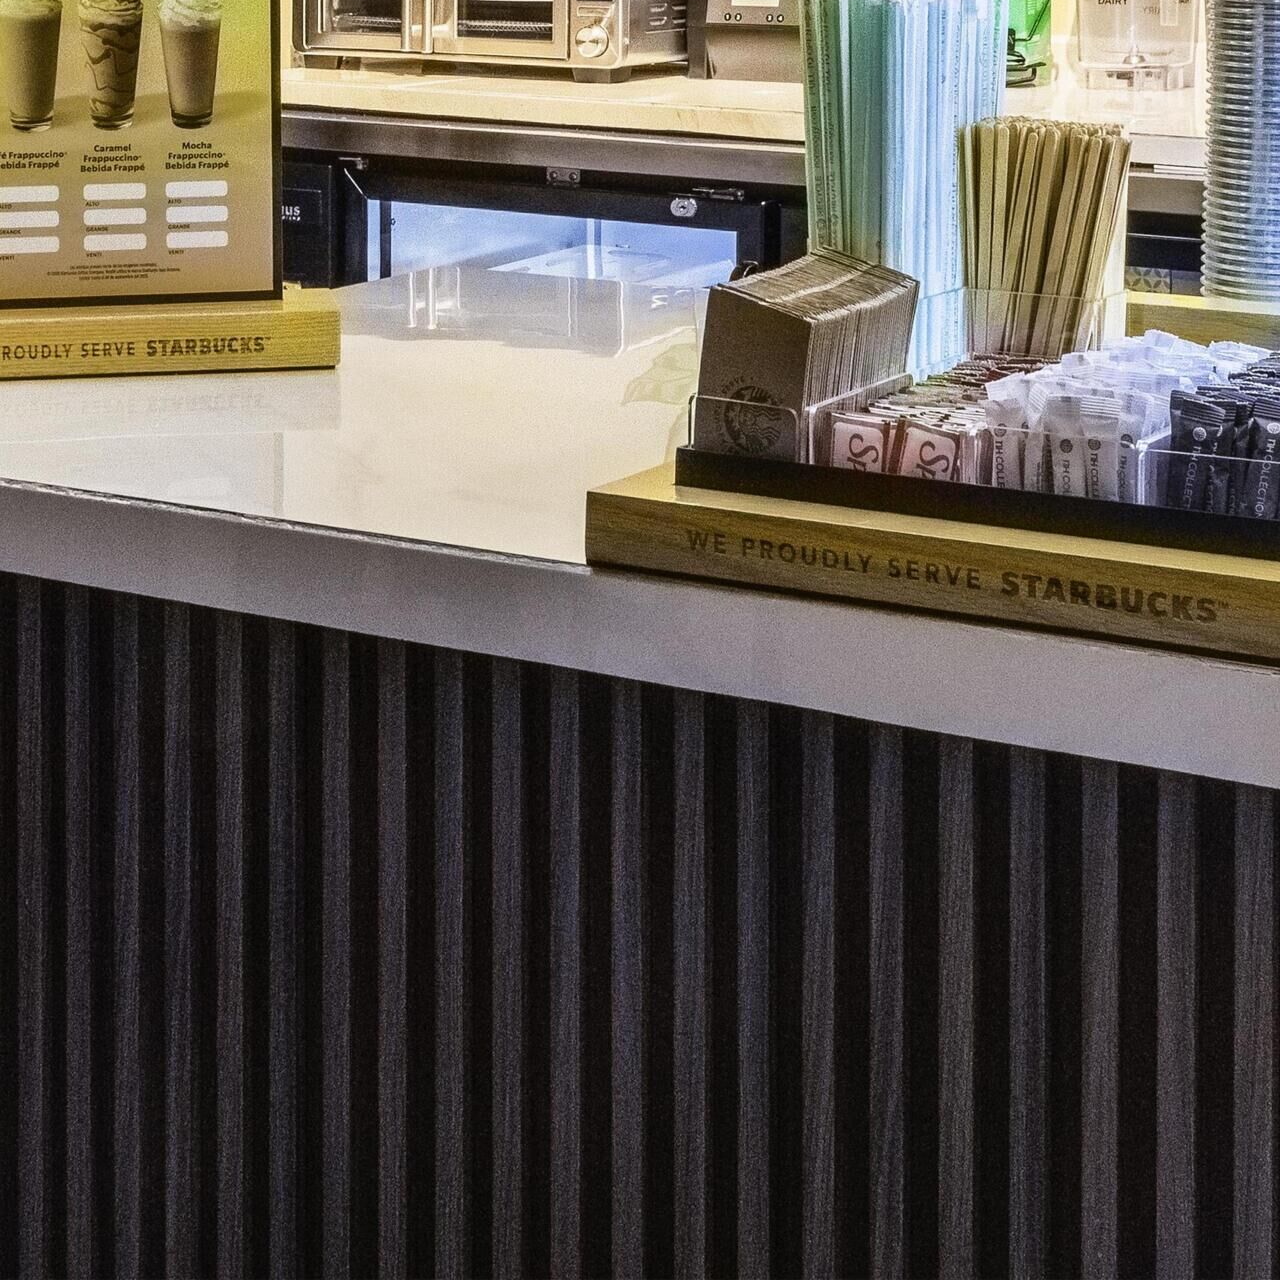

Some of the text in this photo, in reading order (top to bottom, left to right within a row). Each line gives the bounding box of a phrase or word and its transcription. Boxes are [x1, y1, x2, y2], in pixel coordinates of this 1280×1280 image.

[93, 144, 132, 152] Caramel
[181, 141, 212, 150] Mocha
[28, 160, 60, 170] Frappé
[80, 163, 146, 173] Bebida Frappé
[165, 160, 230, 170] Bebida Frappé
[80, 341, 136, 358] SERVE
[686, 529, 727, 555] WE
[741, 537, 874, 573] PROUDLY
[888, 557, 982, 590] SERVE
